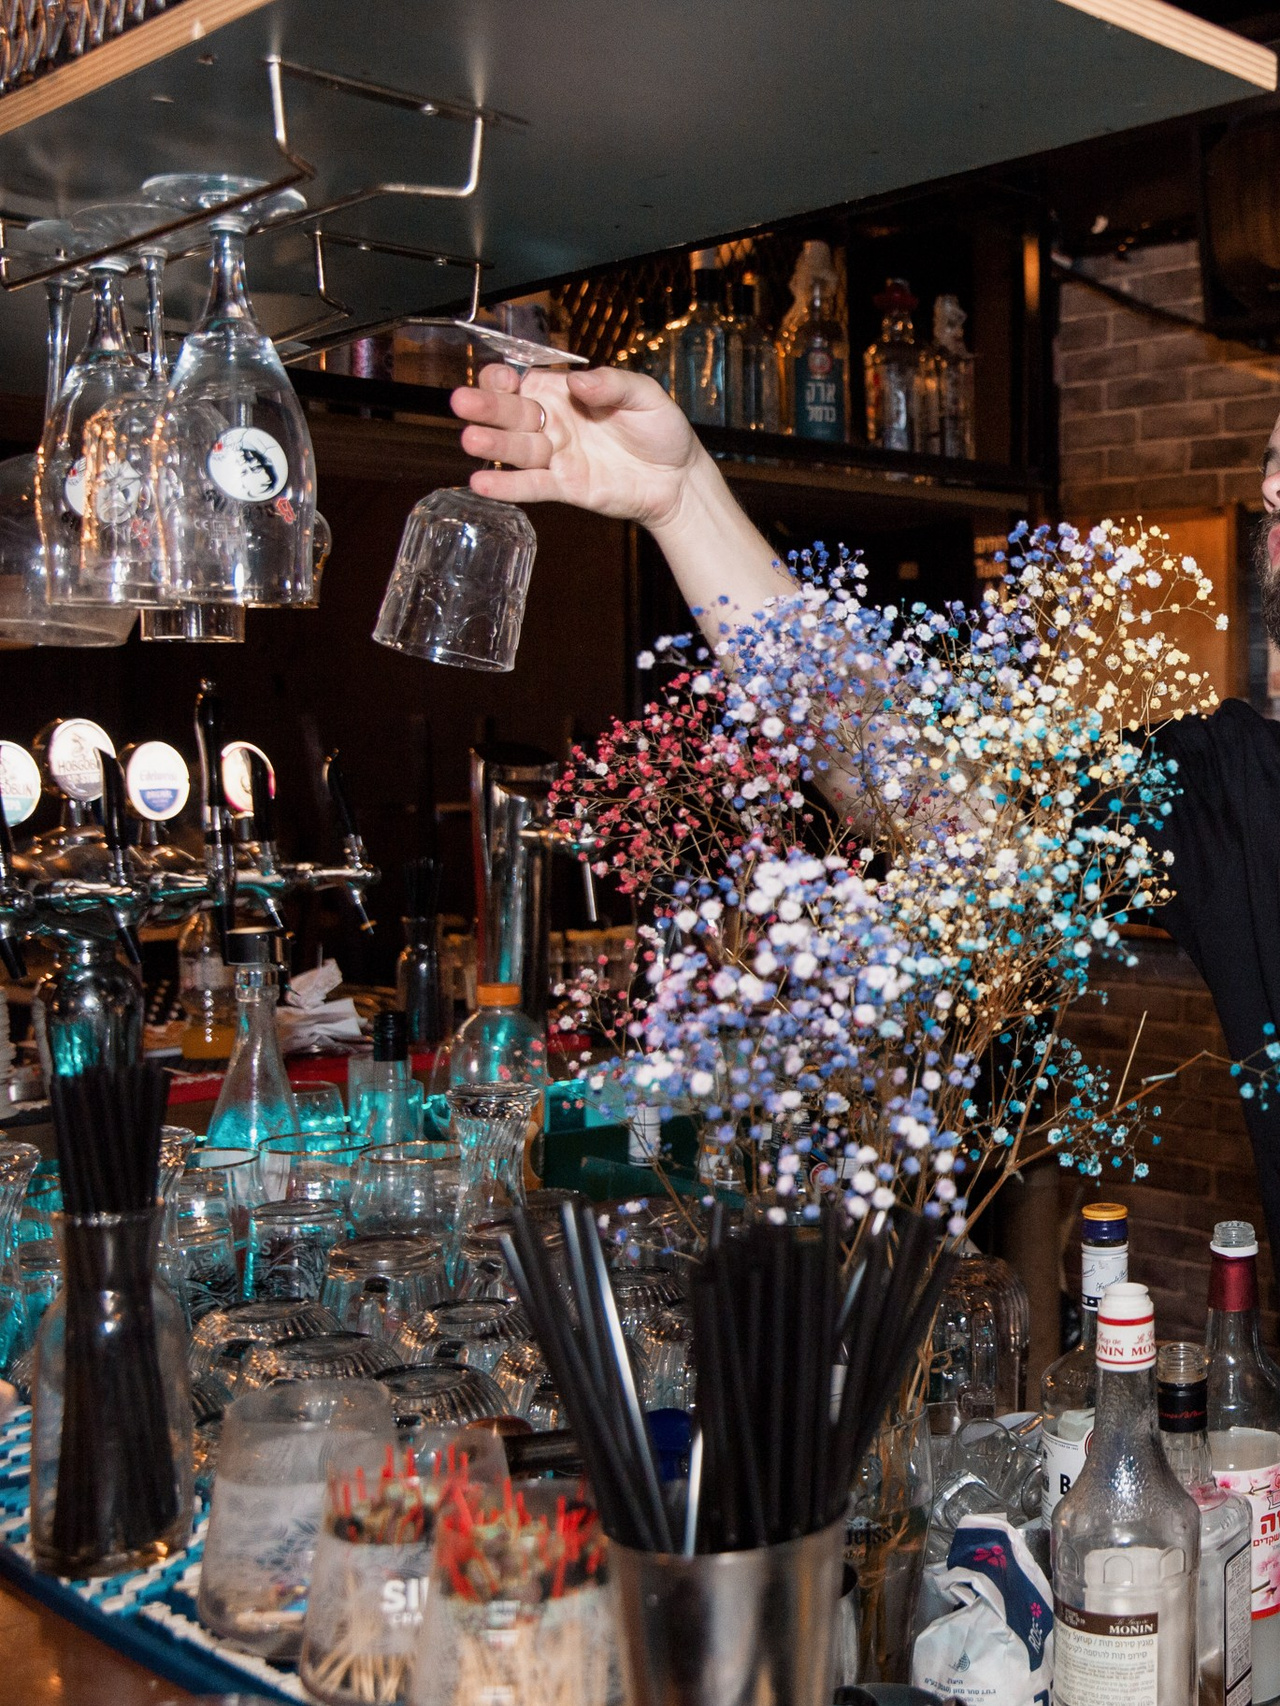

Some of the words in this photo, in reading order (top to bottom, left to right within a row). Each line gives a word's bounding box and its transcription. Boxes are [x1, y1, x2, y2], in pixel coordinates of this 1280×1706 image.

[1252, 1532, 1280, 1547] שקדים
[1109, 1623, 1154, 1634] MONIN
[1072, 1630, 1093, 1645] Syrup
[1098, 1639, 1114, 1647] תות
[1111, 1652, 1126, 1660] תות
